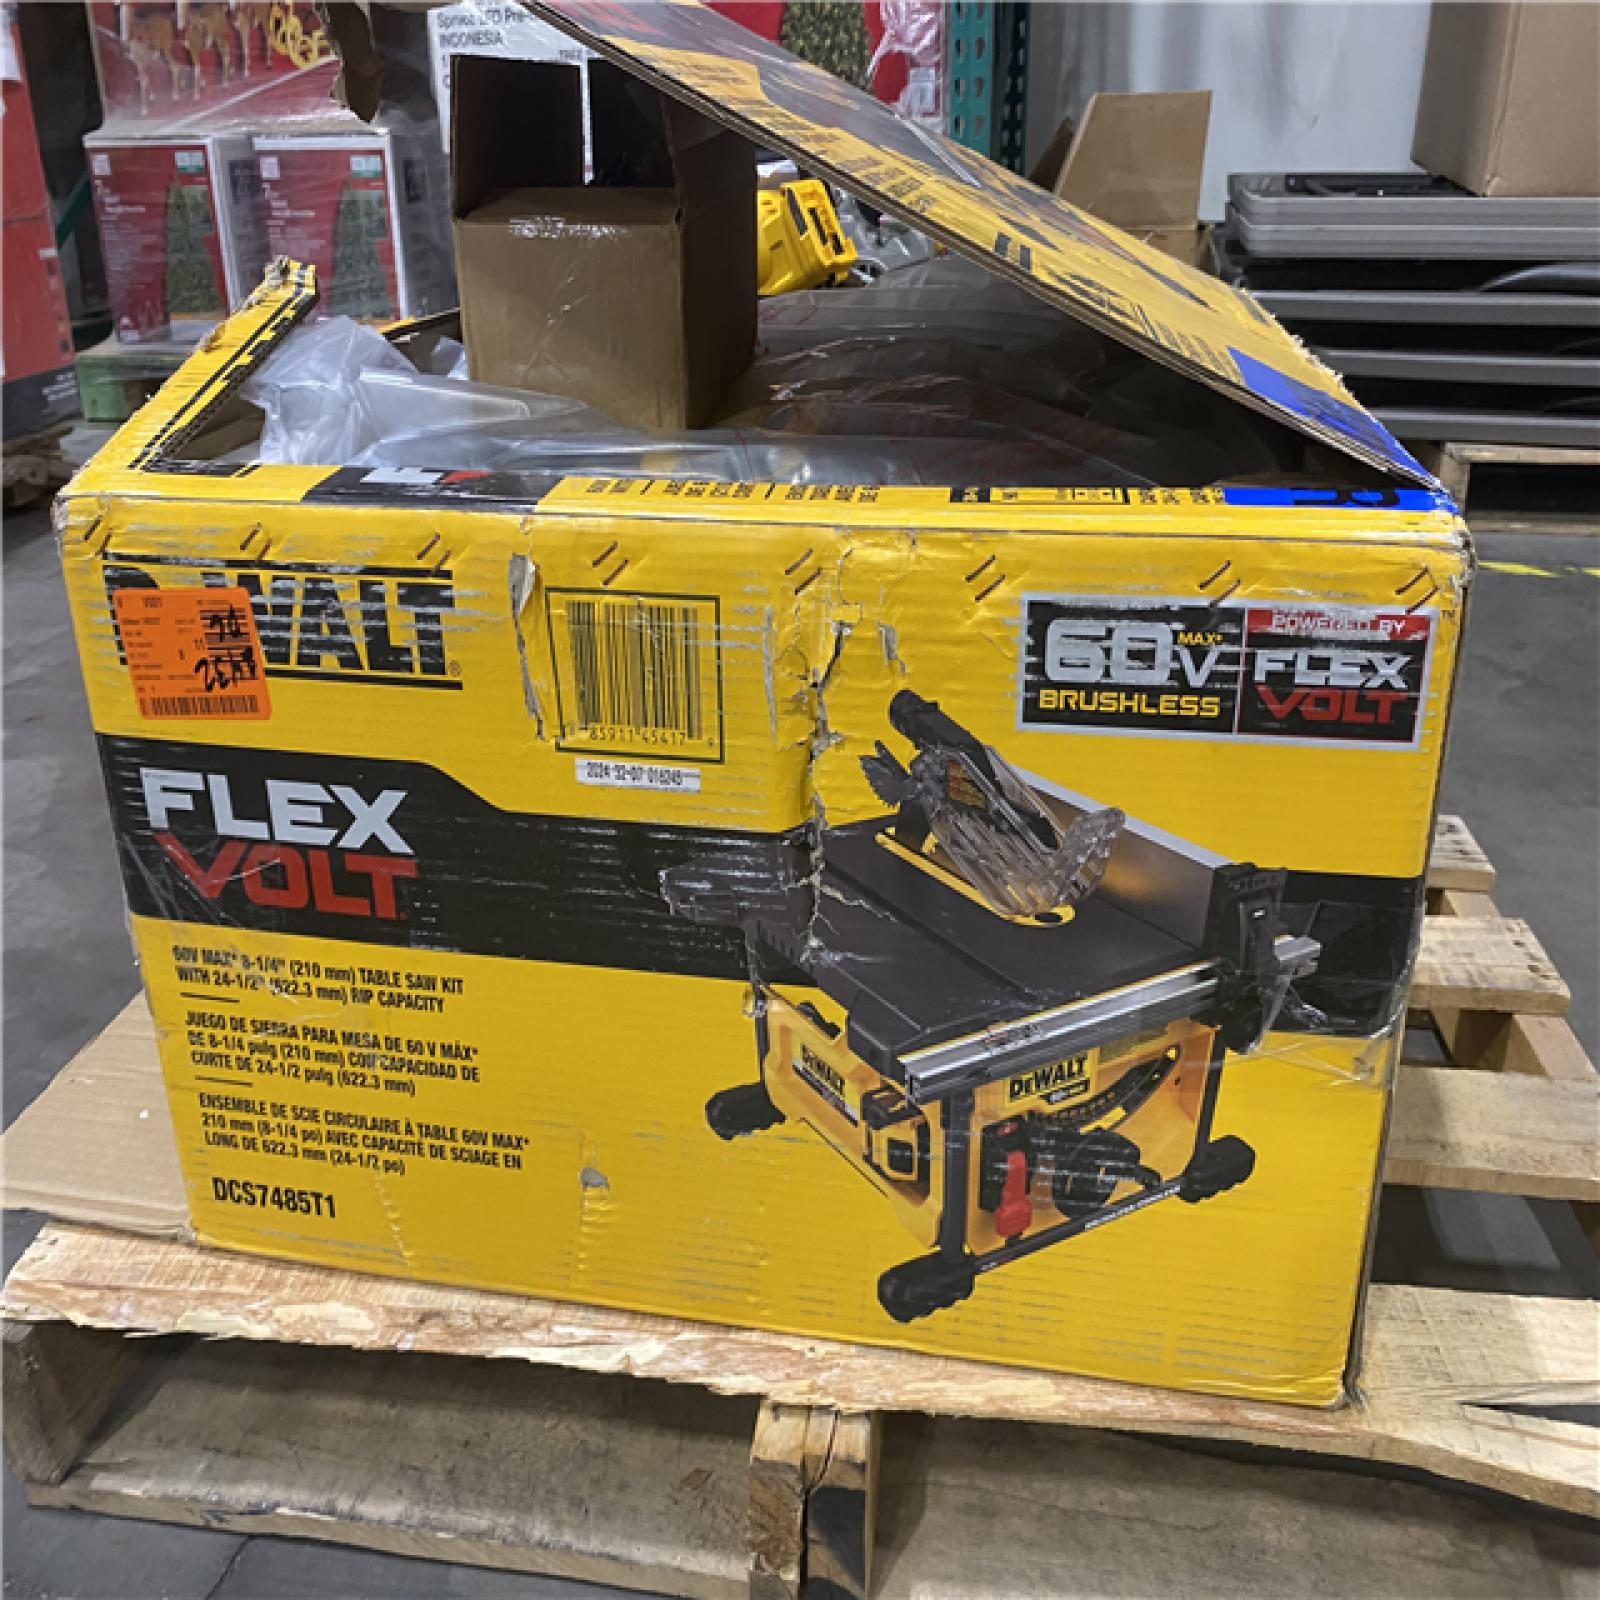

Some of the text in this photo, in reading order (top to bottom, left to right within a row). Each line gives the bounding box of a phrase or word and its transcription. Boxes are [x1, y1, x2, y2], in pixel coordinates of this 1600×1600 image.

[439, 31, 503, 48] INDONESIA
[1378, 615, 1407, 634] BY
[1254, 647, 1413, 689] FLEX
[1038, 688, 1221, 719] BRUSHLESS
[1254, 684, 1410, 725] VOLT
[139, 766, 416, 856] FLEX
[152, 831, 419, 921] VOLT
[175, 965, 211, 984] WITH
[316, 986, 347, 1005] mm)
[351, 986, 374, 1005] RIP
[376, 990, 445, 1013] CAPACITY
[289, 959, 321, 979] (210
[324, 965, 356, 985] mm)
[357, 967, 402, 988] TABLE
[404, 972, 438, 992] SAW
[441, 976, 464, 995] KIT
[185, 1010, 226, 1031] JUEGO
[229, 1015, 247, 1033] DE
[250, 1018, 300, 1039] SIERRA
[302, 1024, 339, 1045] PARA
[341, 1030, 381, 1050] MESA
[384, 1035, 404, 1053] DE
[406, 1038, 426, 1056] 60
[426, 1040, 437, 1057] V
[187, 1030, 205, 1047] DE
[208, 1032, 246, 1052] 8-1/4
[248, 1040, 276, 1060] pulg
[280, 1042, 311, 1062] (210
[314, 1049, 346, 1069] mm)
[380, 1054, 457, 1079] CAPACIDAD
[460, 1065, 481, 1083] DE
[191, 1050, 416, 1098] CORTE DE 24-1/2 pulg (622.3 mm)
[198, 1092, 267, 1116] ENSEMBLE
[270, 1101, 288, 1119] DE
[291, 1103, 321, 1124] SCIE
[323, 1109, 401, 1135] CIRCULAIRE
[404, 1117, 414, 1137] À
[416, 1121, 459, 1143] TABLE
[461, 1127, 489, 1147] 60V
[201, 1112, 226, 1129] 210
[229, 1119, 255, 1133] mm
[257, 1118, 299, 1139] (8-1/4
[302, 1127, 324, 1144] po)
[325, 1129, 359, 1148] AVEC
[429, 1144, 448, 1161] DE
[449, 1147, 501, 1168] SCIAGE
[504, 1152, 523, 1171] EN
[204, 1130, 407, 1176] LONG DE 622.3 mm (24-1/2 po)
[211, 1175, 337, 1219] DCS7485T1
